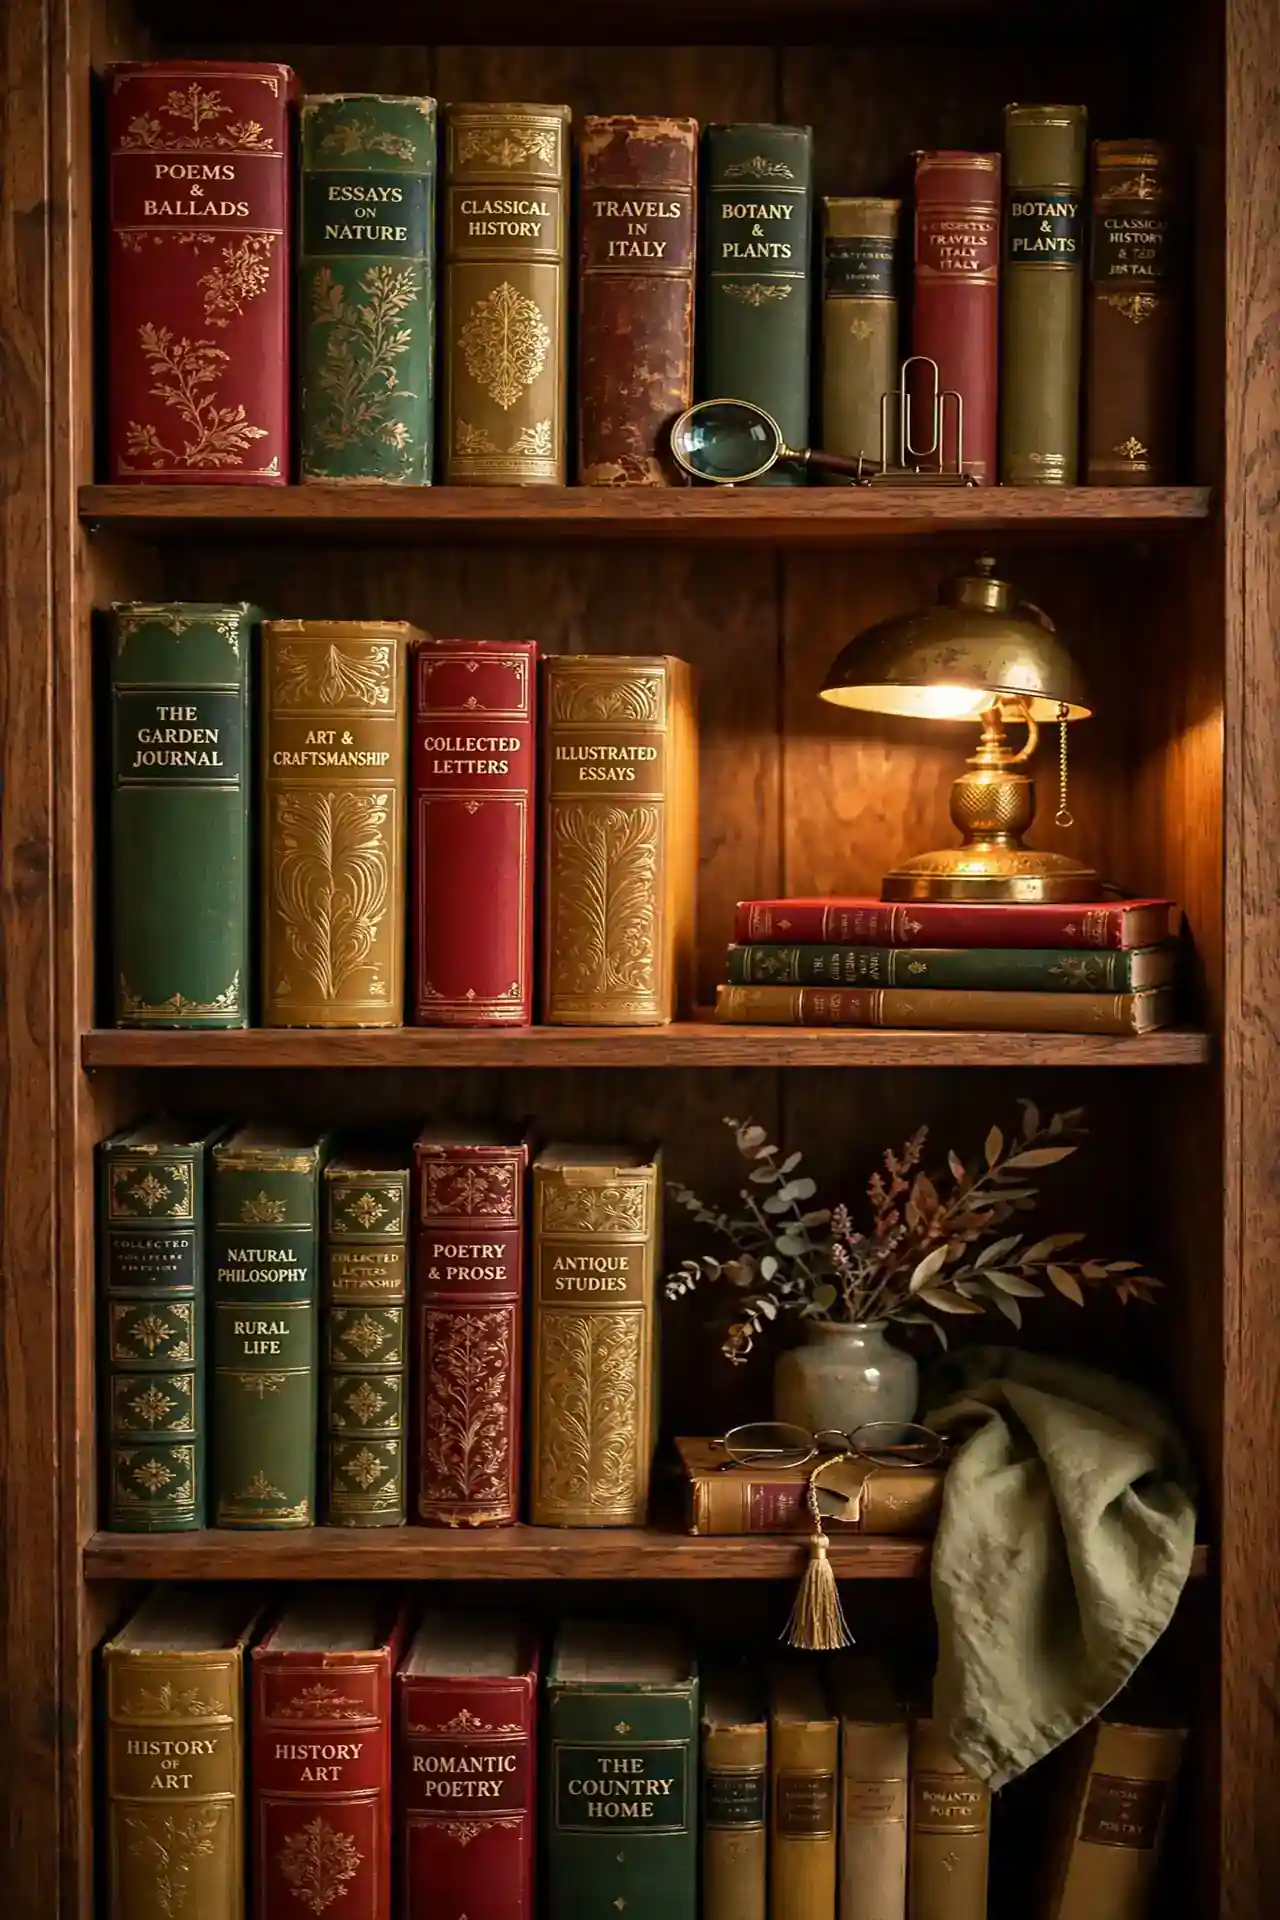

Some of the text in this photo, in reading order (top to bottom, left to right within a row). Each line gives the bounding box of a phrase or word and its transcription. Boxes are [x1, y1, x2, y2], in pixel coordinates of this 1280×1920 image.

[156, 165, 235, 180] POEMS
[190, 184, 204, 196] &
[329, 187, 402, 202] ESSAYS
[145, 201, 249, 216] BALLADS
[355, 208, 376, 217] ON
[461, 201, 550, 216] CLASSICAL
[597, 202, 680, 218] TRAVELS
[723, 204, 794, 219] BOTANY
[1012, 203, 1079, 217] BOTANY
[326, 225, 407, 241] NATURE
[468, 221, 541, 237] HISTORY
[628, 224, 647, 235] IN
[752, 224, 764, 236] &
[1040, 220, 1051, 232] &
[609, 241, 666, 257] ITALY
[723, 243, 791, 258] PLANTS
[1014, 238, 1075, 251] PLANTS
[157, 707, 197, 720] THE
[138, 729, 219, 743] GARDEN
[306, 731, 353, 744] ART &
[424, 738, 520, 752] COLLECTED
[134, 751, 223, 767] JOURNAL
[274, 752, 390, 766] CRAFTSMANSHIP
[556, 747, 657, 761] ILLUSTRATED
[434, 760, 508, 774] LETTERS
[580, 767, 635, 781] ESSAYS
[228, 1249, 297, 1262] NATURAL
[434, 1244, 506, 1258] POETRY
[553, 1256, 630, 1273] ANTIQUE
[219, 1268, 307, 1282] PHILOSOPHY
[429, 1266, 507, 1280] & PROSE
[556, 1277, 627, 1290] STUDIES
[235, 1321, 289, 1334] RURAL
[244, 1341, 280, 1354] LIFE
[129, 1739, 219, 1755] HISTORY
[277, 1744, 364, 1759] HISTORY
[161, 1760, 179, 1769] OF
[414, 1755, 516, 1772] ROMANTIC
[598, 1759, 643, 1773] THE
[301, 1766, 342, 1780] ART
[151, 1775, 192, 1788] ART
[426, 1780, 503, 1797] POETRY
[569, 1779, 674, 1795] COUNTRY
[589, 1802, 653, 1817] HOME
